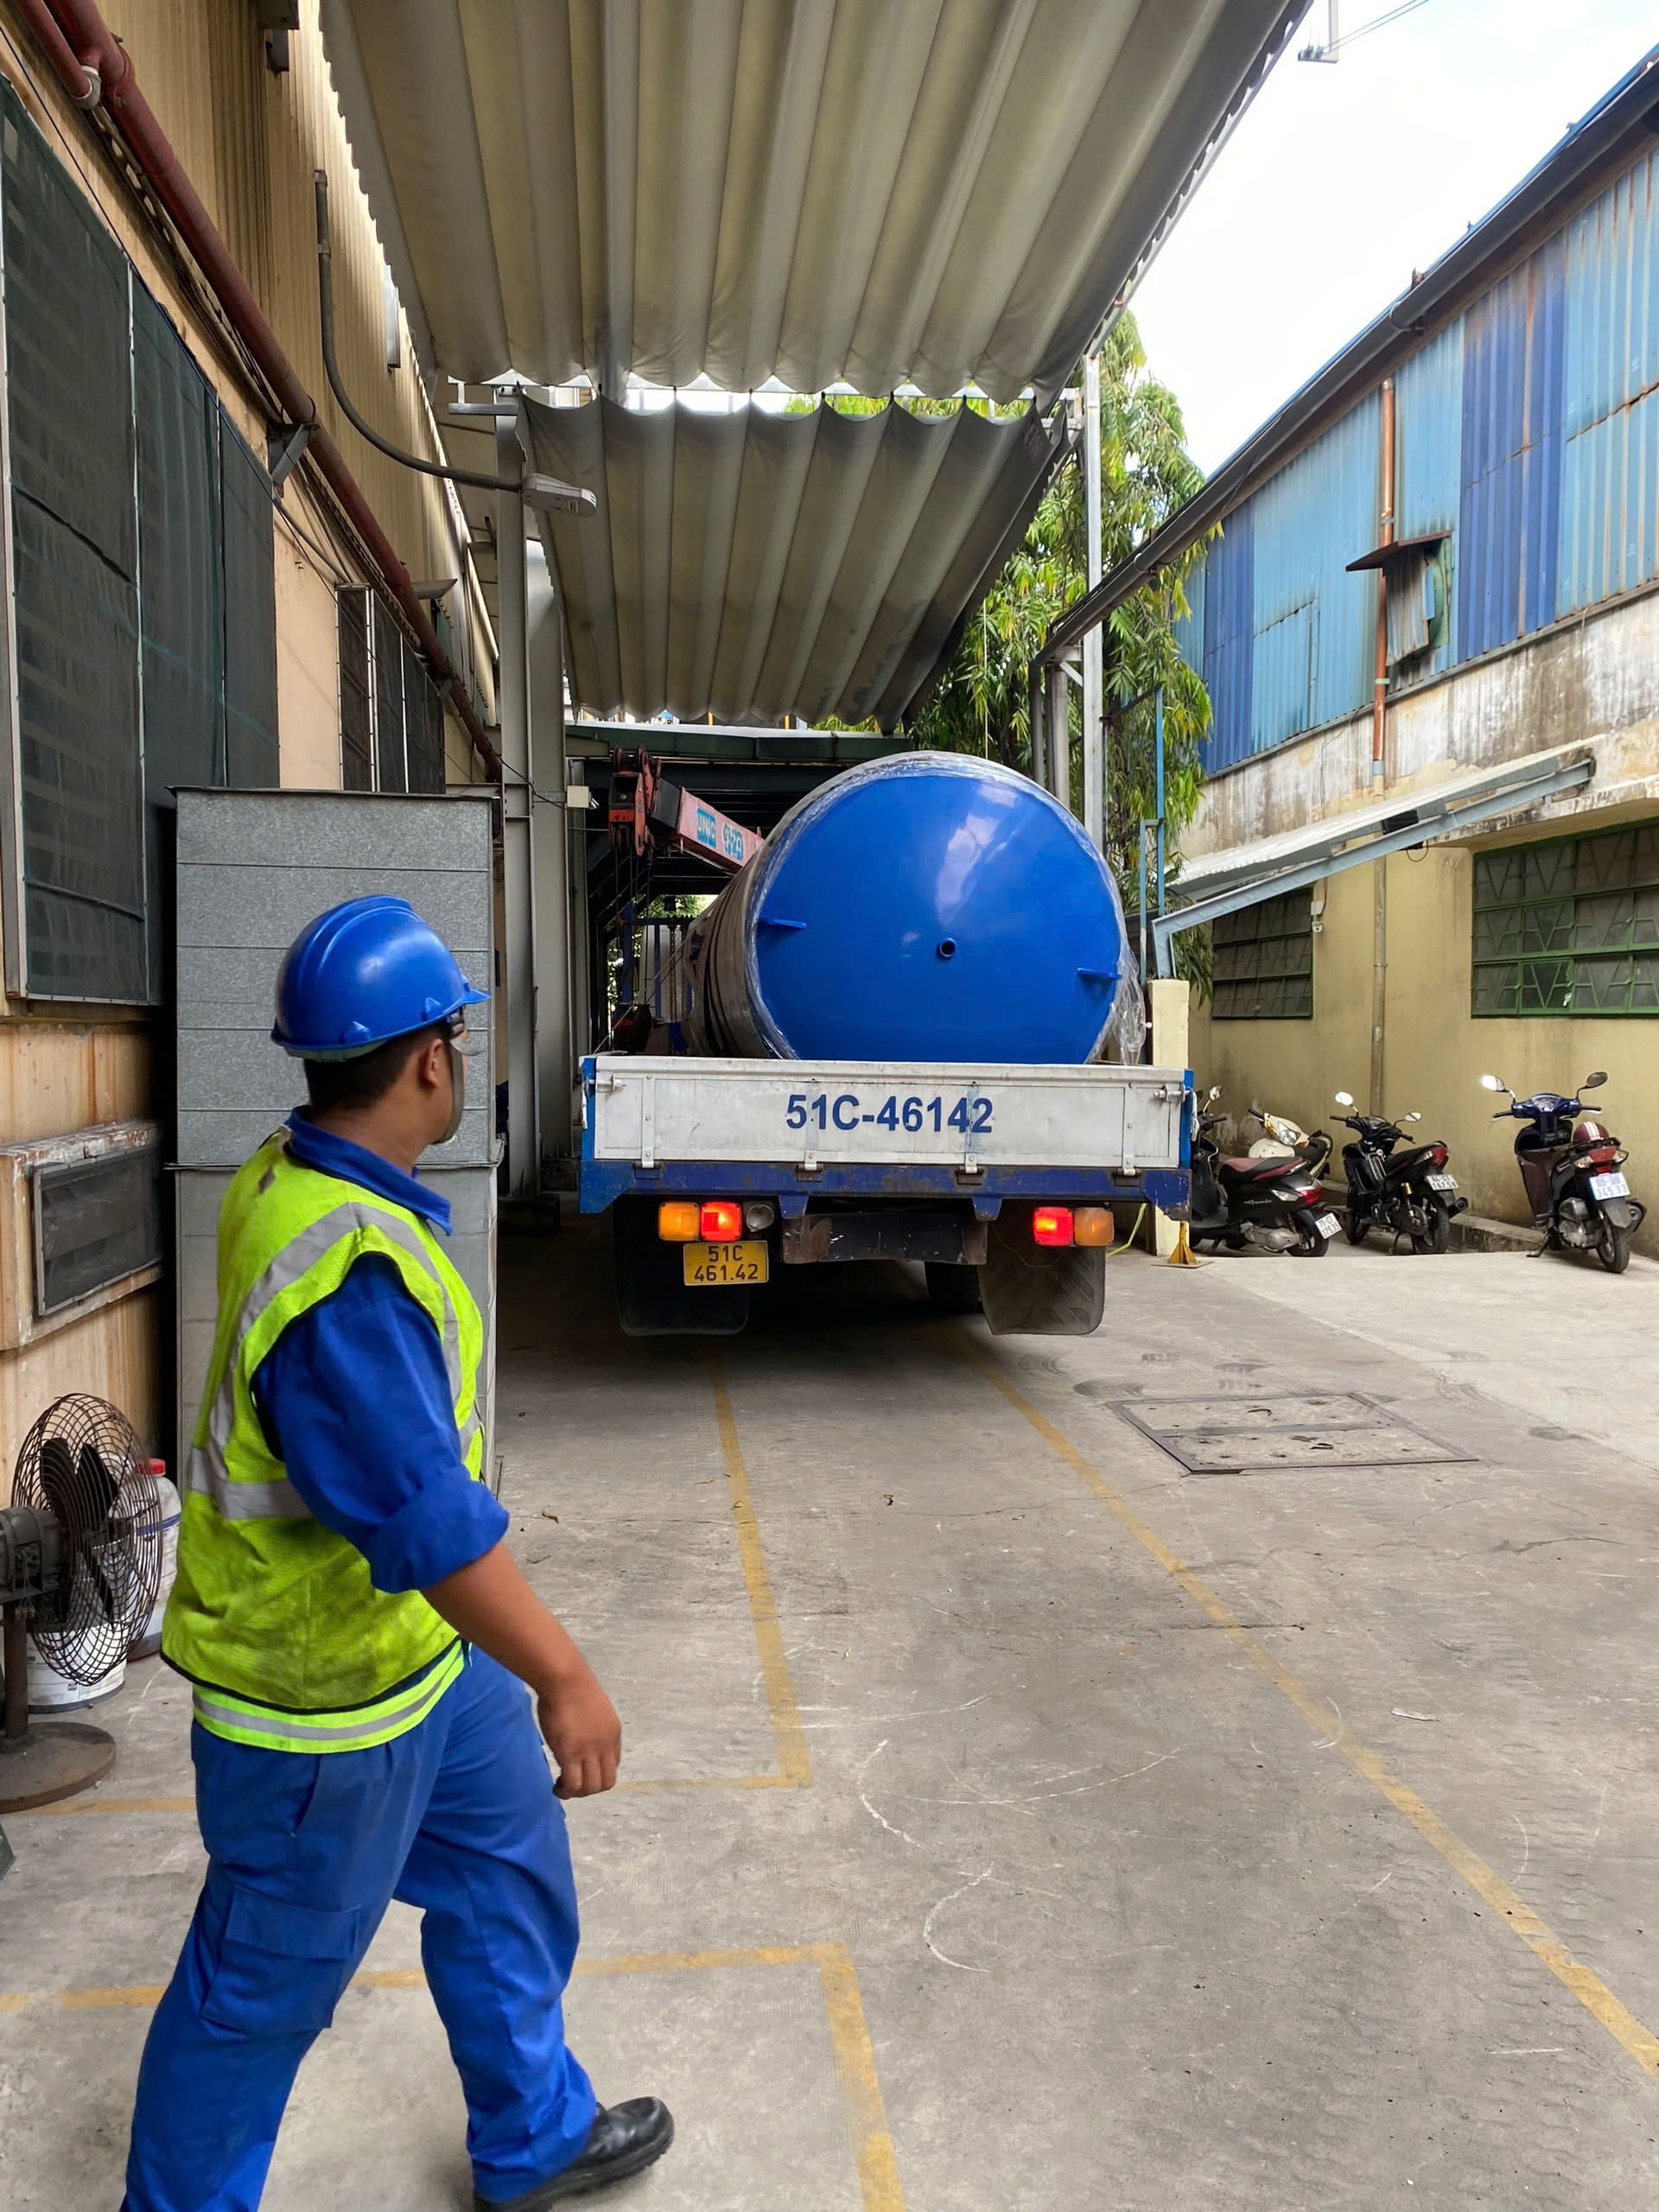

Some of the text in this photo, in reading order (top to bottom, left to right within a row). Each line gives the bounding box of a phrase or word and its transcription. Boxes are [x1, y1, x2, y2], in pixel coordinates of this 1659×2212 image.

[786, 1094, 993, 1134] 51C-46142
[708, 1245, 743, 1262] 51C
[694, 1263, 759, 1281] 461.42
